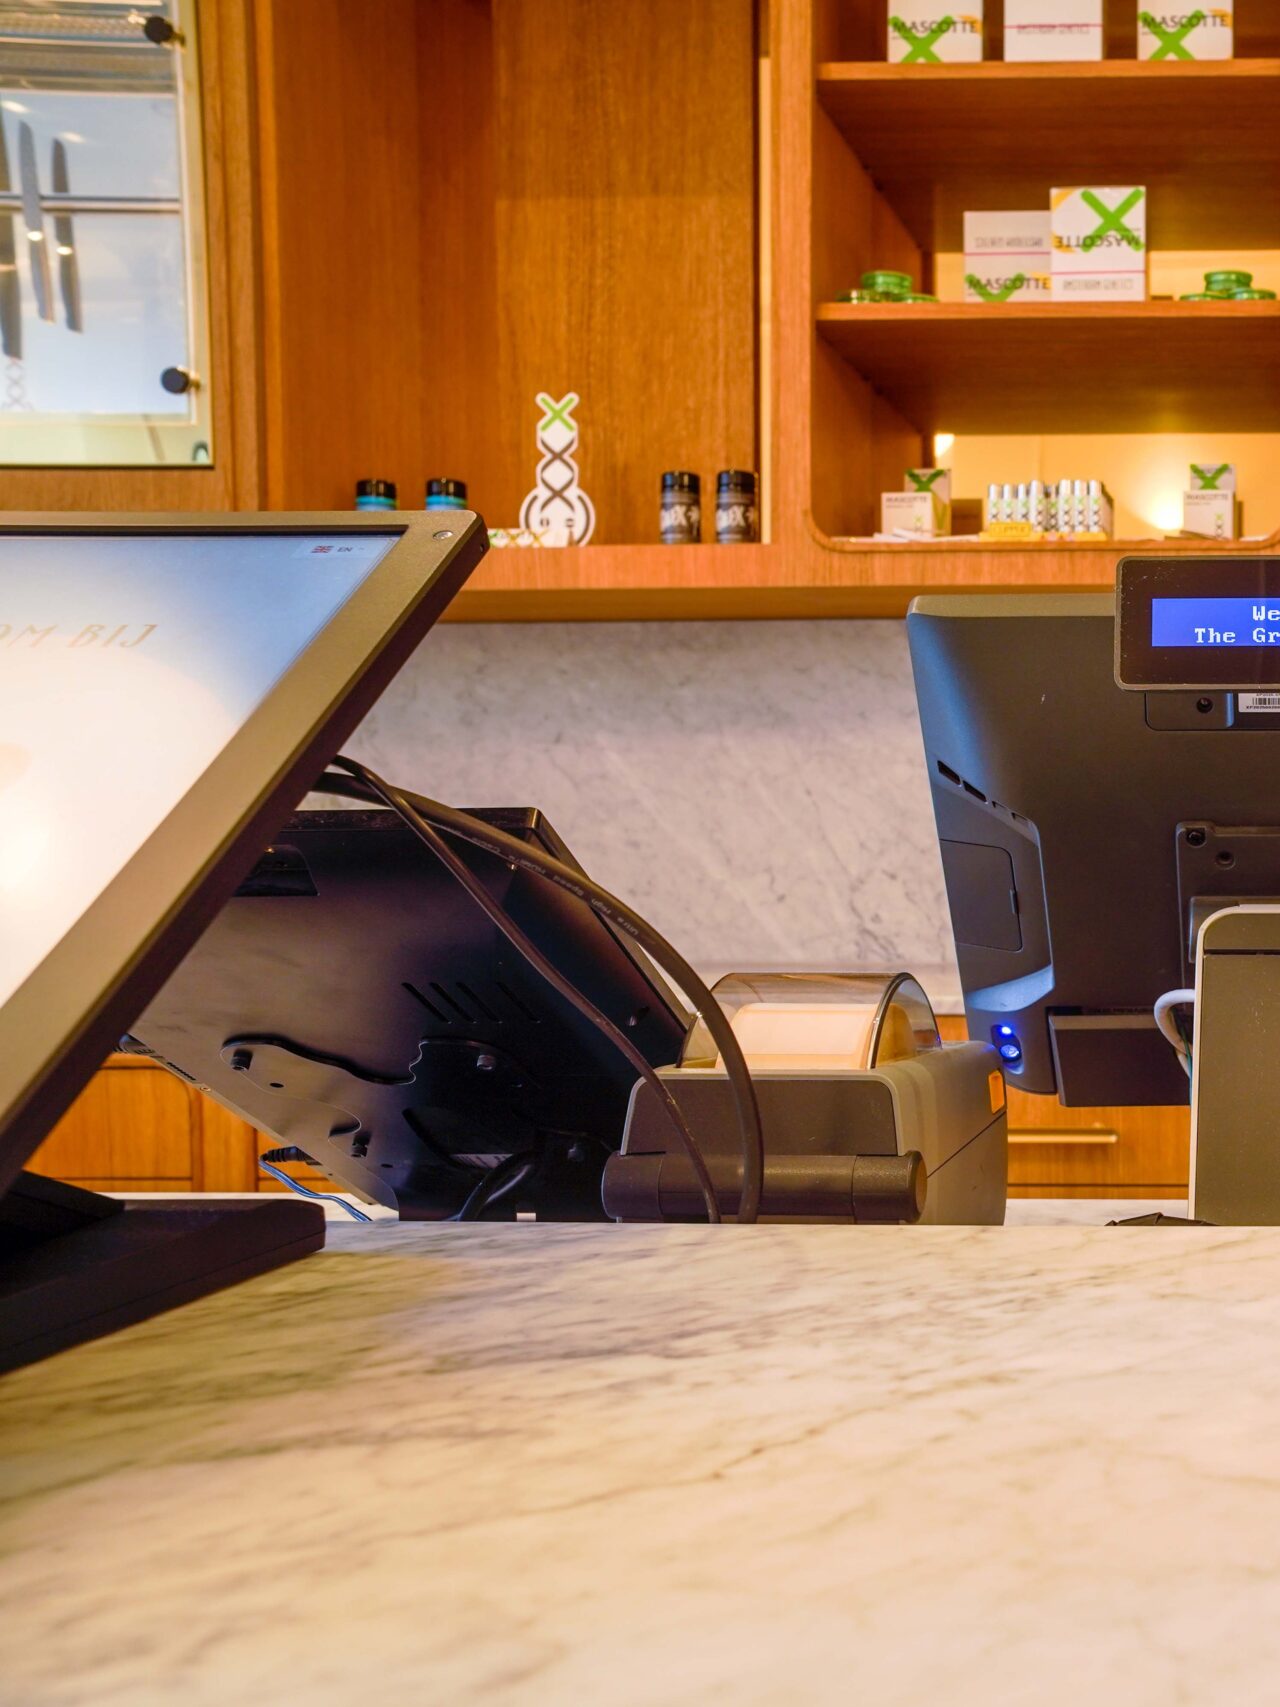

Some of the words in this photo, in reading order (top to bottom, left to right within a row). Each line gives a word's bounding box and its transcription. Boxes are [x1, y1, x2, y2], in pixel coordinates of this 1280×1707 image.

[892, 20, 978, 34] MASCOTTE
[1142, 14, 1229, 28] MASCOTTE
[1055, 234, 1141, 249] MASCOTTE
[968, 277, 1050, 290] MASCOTTE
[67, 623, 158, 648] BIJ
[1194, 628, 1236, 643] The
